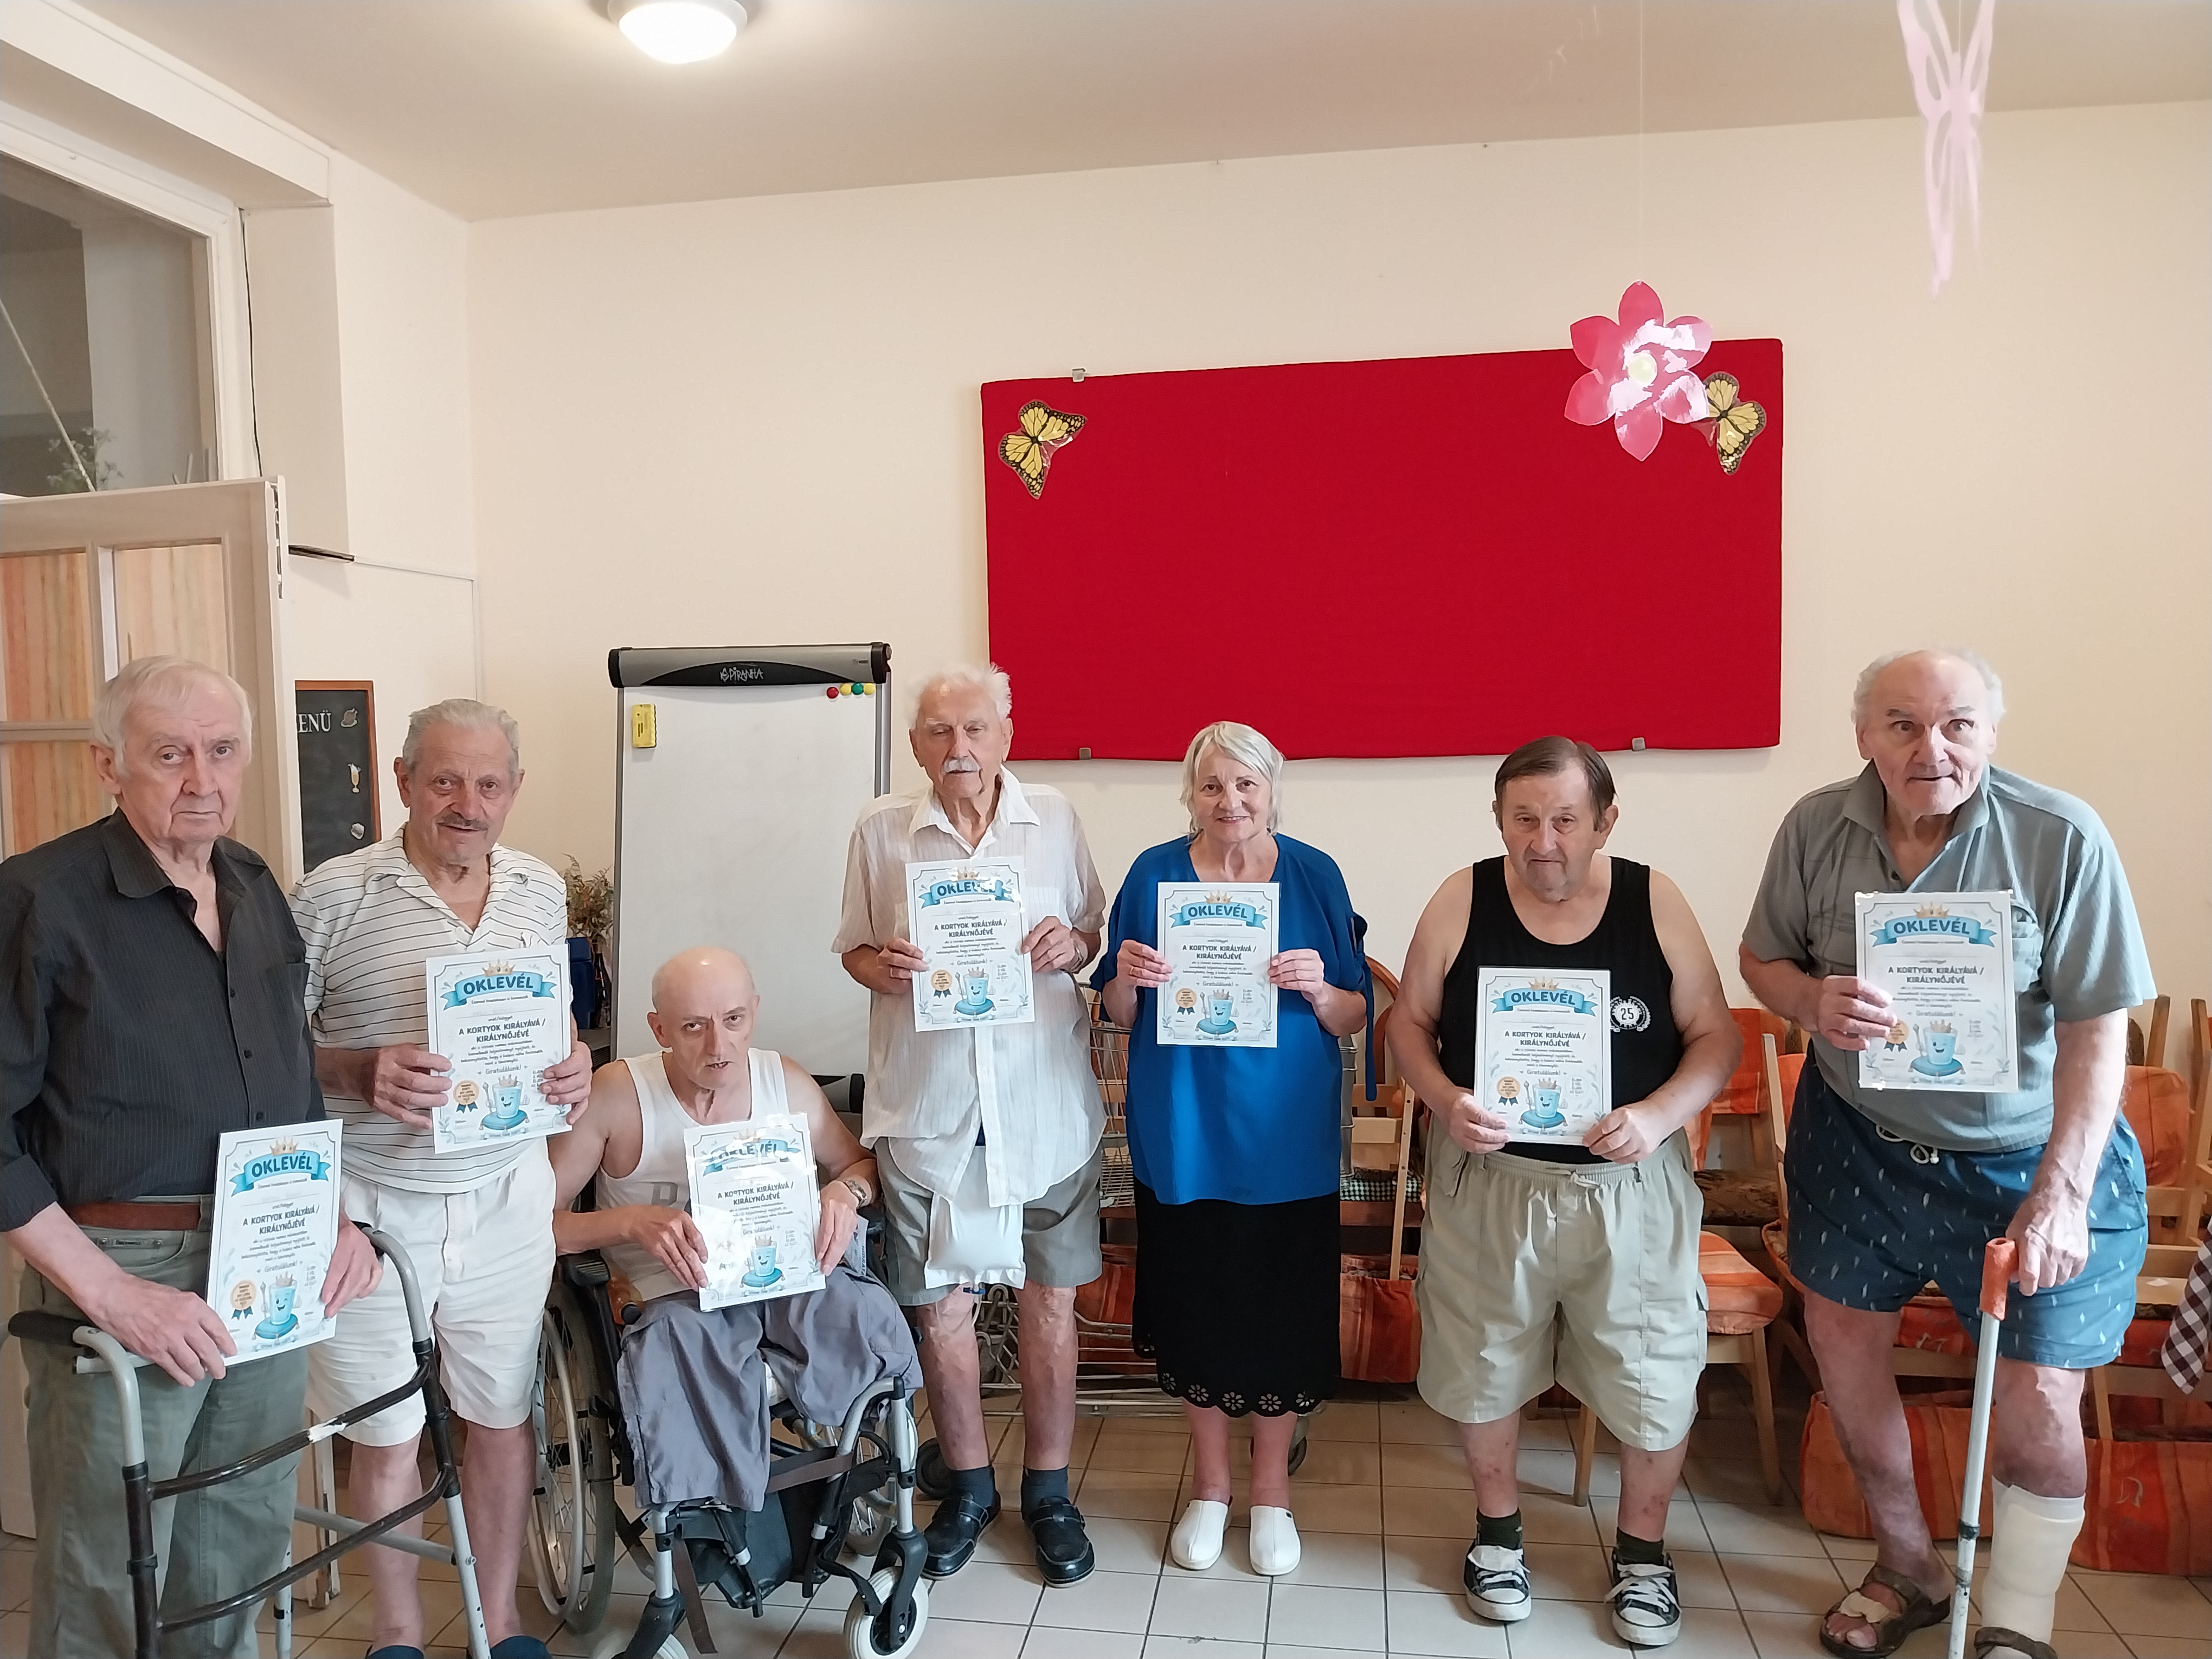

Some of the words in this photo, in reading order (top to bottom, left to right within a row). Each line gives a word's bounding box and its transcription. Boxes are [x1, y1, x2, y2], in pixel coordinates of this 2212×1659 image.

[297, 709, 331, 733] ENÜ
[937, 882, 996, 896] OKLEV
[1188, 904, 1248, 918] OKLEVÉL
[972, 918, 1002, 928] KIRÁLYÁVÁ
[1894, 917, 1970, 935] OKLEVÉL
[949, 928, 994, 938] KIRÁLYNŐJÉVÉ
[464, 973, 534, 994] OKLEVÉL
[1511, 991, 1576, 1005] OKLEVÉL
[1621, 1007, 1634, 1020] 25
[467, 1024, 501, 1034] KORTYOK
[504, 1018, 541, 1030] KIRÁLYÁVÁ
[542, 1018, 546, 1026] /
[476, 1028, 530, 1043] KIRÁLYNŐJÉVÉ
[1520, 1038, 1570, 1047] KIRÁLYNŐJÉVÉ
[1581, 1032, 1586, 1040] /
[485, 1064, 522, 1075] Gratulálunk!
[252, 1152, 312, 1178] OKLEVÉL
[756, 1181, 790, 1193] KIRÁLYÁVÁ
[733, 1191, 781, 1206] KIRÁLYNŐJÉVÉ
[242, 1218, 248, 1226] A
[250, 1213, 283, 1225] KORTYOK
[285, 1205, 315, 1219] KIRÁLYÁVÁ
[259, 1217, 305, 1235] KIRÁLYNŐJÉVÉ
[742, 1225, 775, 1236] Graulálunk!
